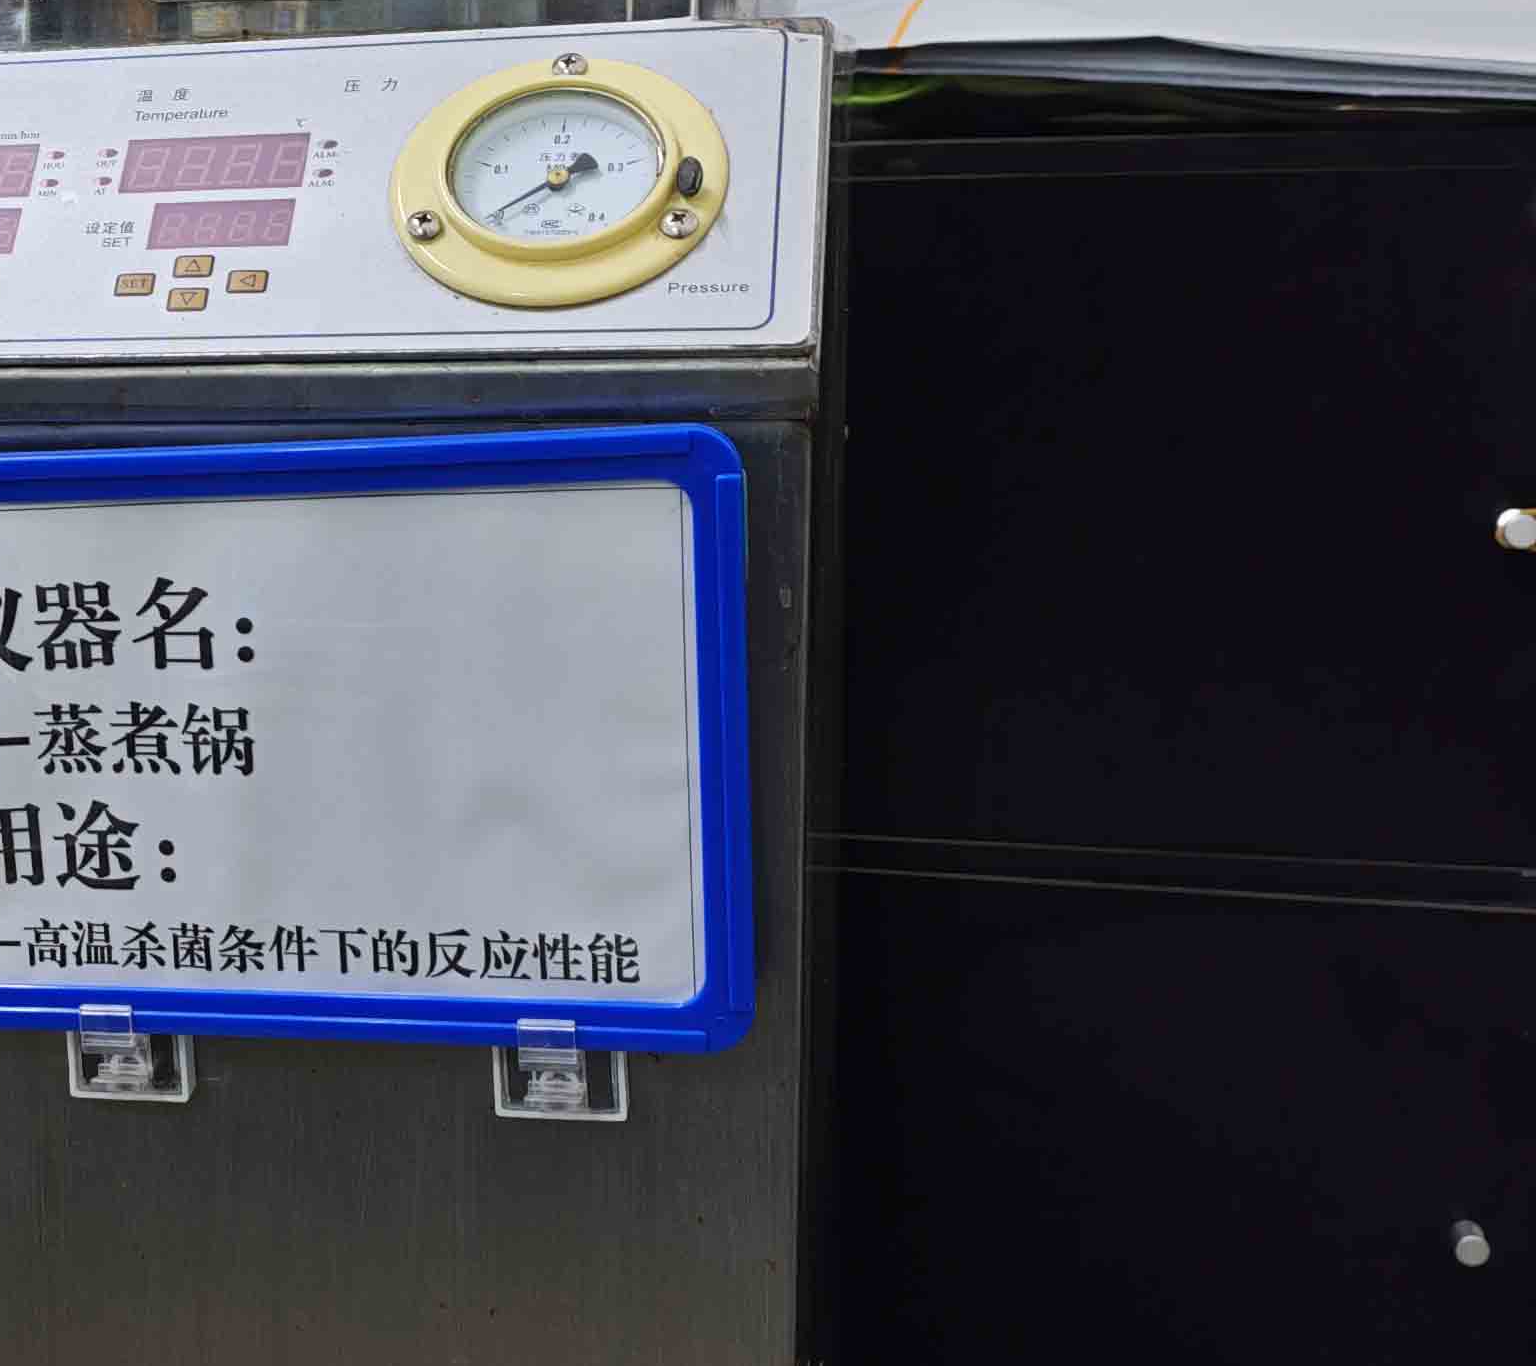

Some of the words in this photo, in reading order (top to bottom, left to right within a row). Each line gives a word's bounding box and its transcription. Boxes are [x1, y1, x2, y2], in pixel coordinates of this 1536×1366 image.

[137, 88, 193, 103] 温度
[135, 107, 229, 123] Temperature
[85, 220, 135, 234] 设定值
[101, 236, 132, 248] SET
[121, 278, 149, 289] SET
[667, 282, 751, 295] Pressure
